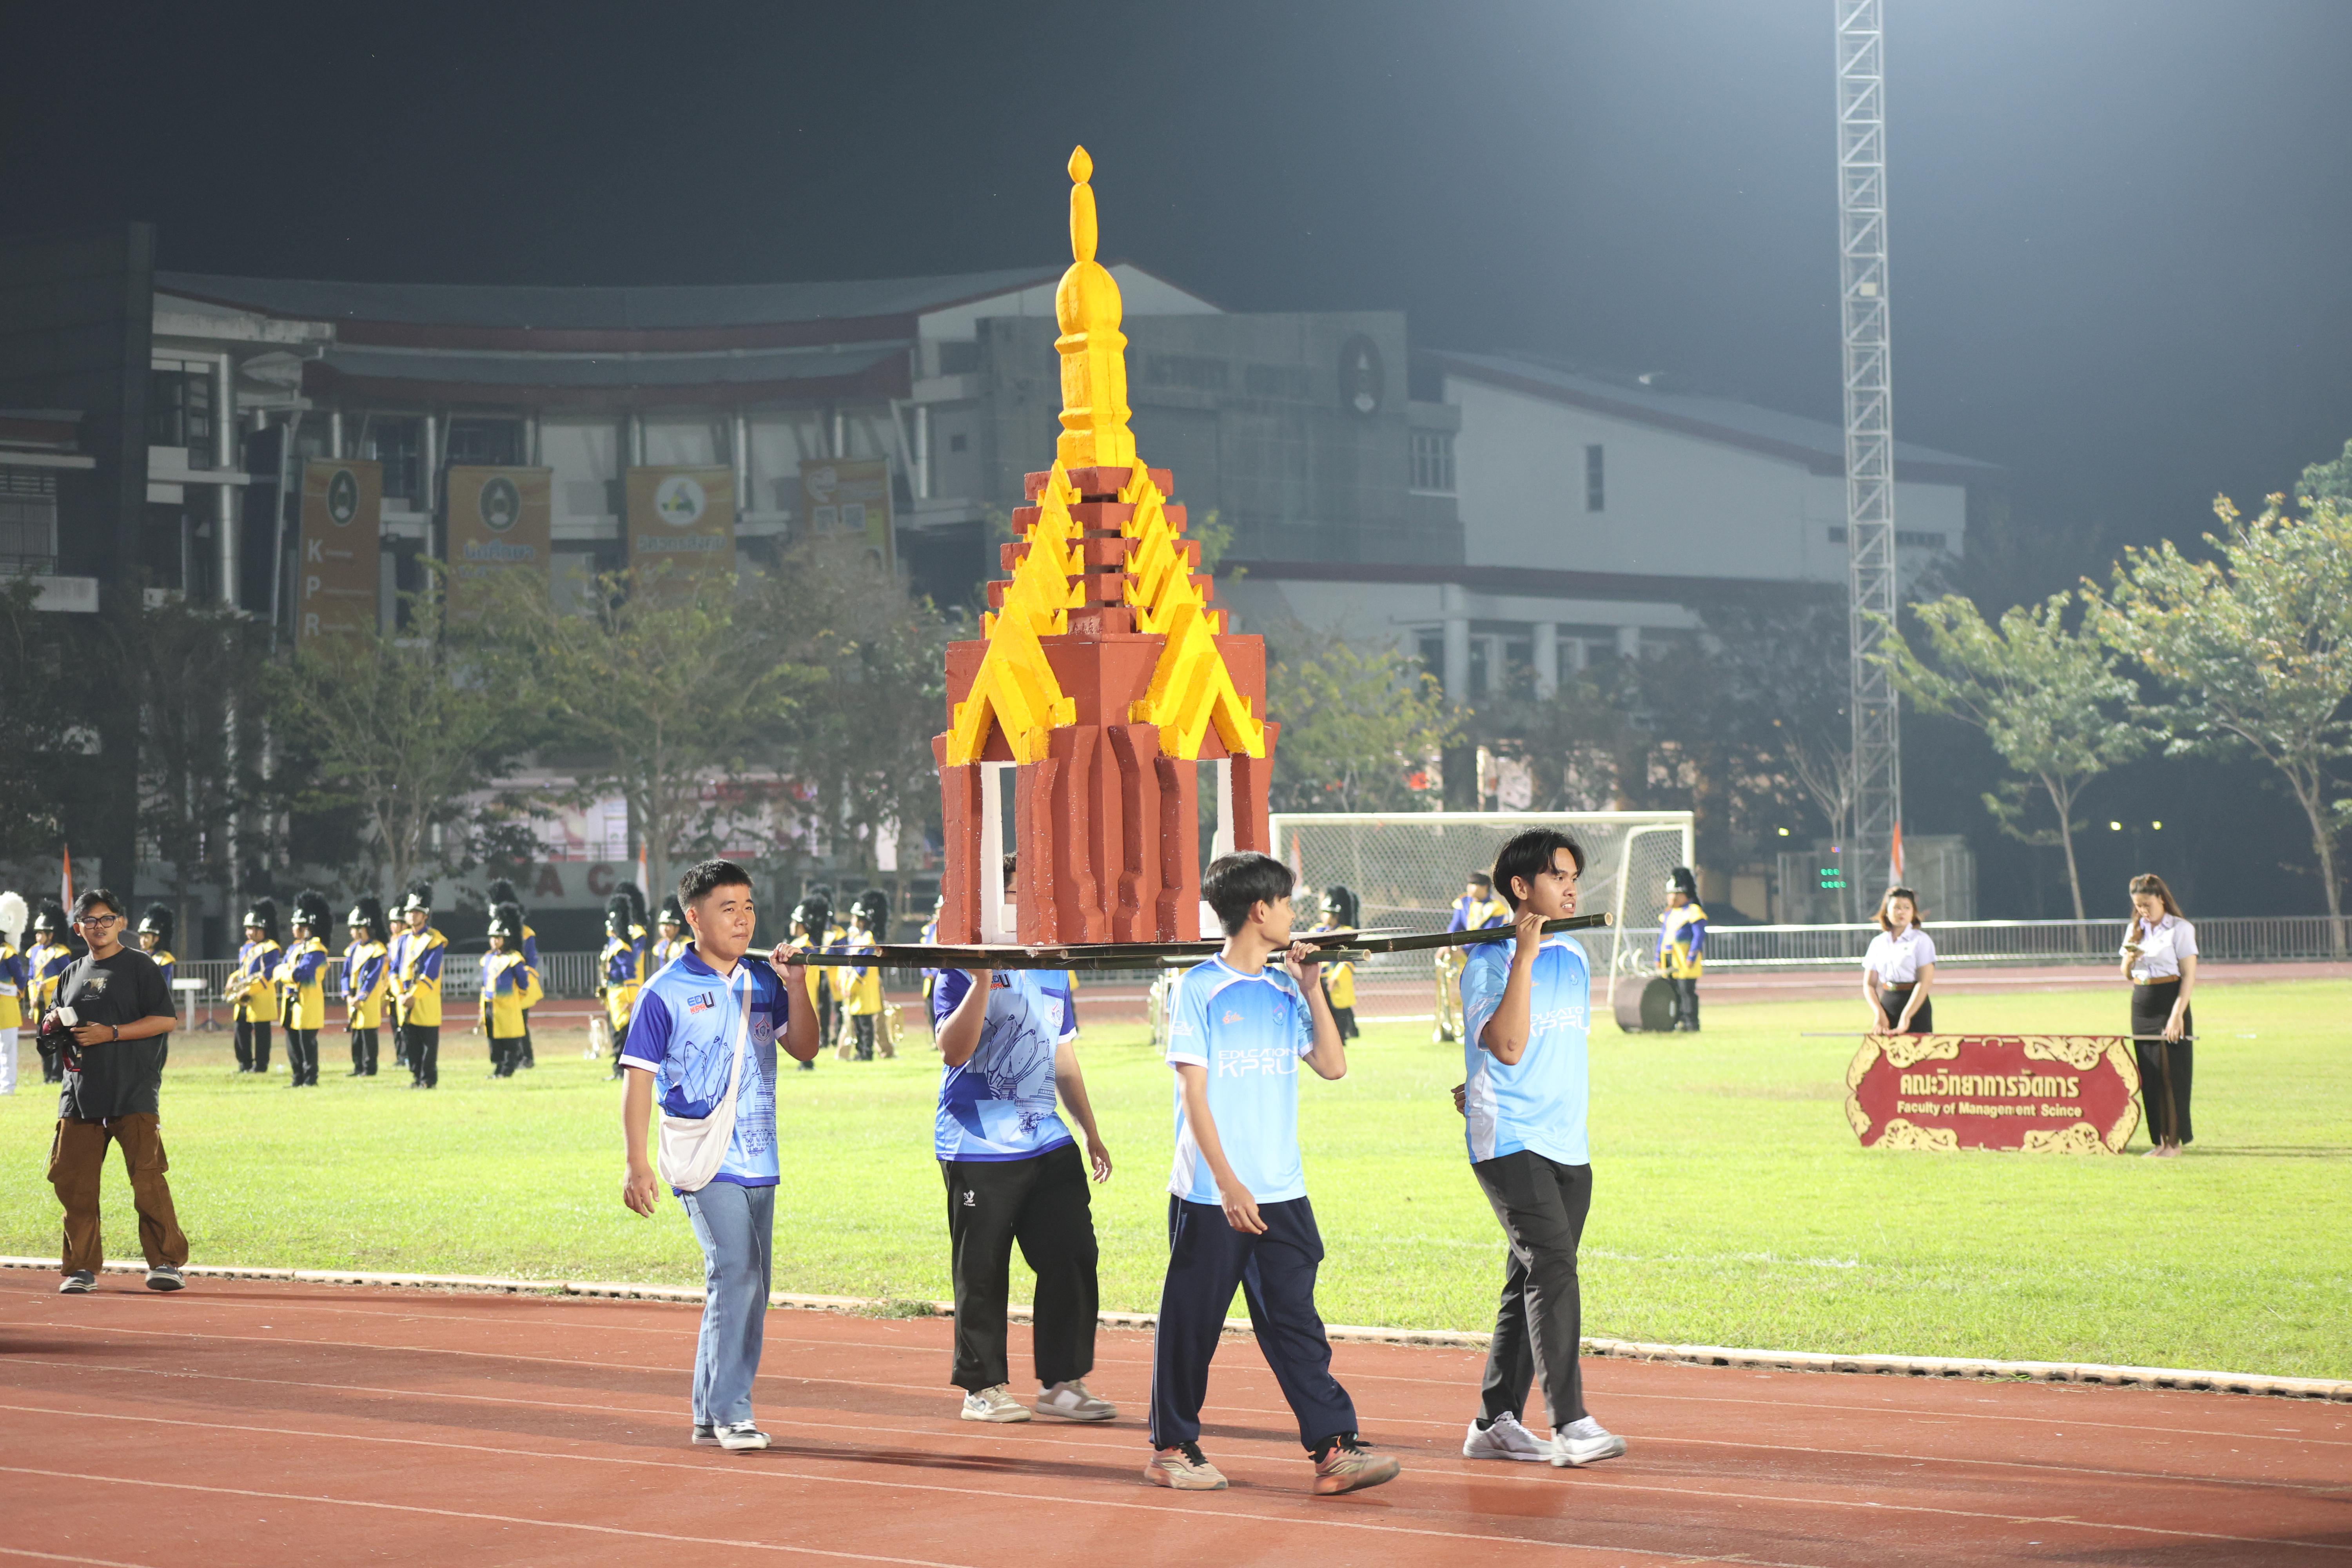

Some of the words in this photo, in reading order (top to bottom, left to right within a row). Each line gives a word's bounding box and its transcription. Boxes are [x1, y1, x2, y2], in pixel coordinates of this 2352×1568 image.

[687, 991, 715, 1008] EDU
[1218, 1046, 1297, 1059] EDUCATION
[1218, 1055, 1298, 1078] KPRU
[1900, 1068, 2080, 1098] คณะวิทยาการจัดการ
[1897, 1100, 1940, 1117] Faculty
[1943, 1102, 1956, 1115] of
[2041, 1103, 2083, 1118] Scince
